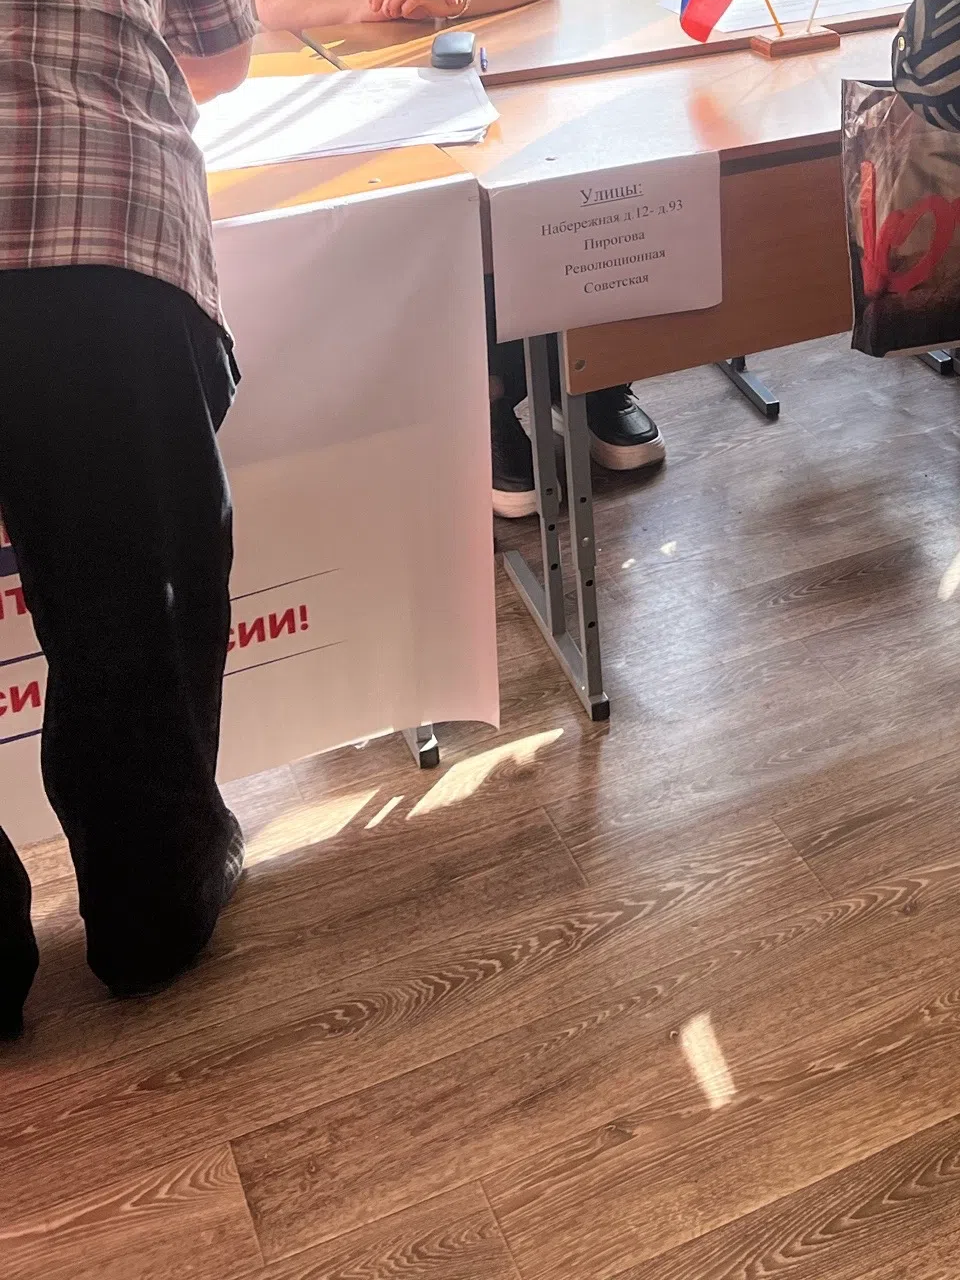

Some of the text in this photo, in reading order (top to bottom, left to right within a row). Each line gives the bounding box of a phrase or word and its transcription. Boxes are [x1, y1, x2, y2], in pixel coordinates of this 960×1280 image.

[580, 183, 644, 205] Улицы:
[541, 213, 620, 237] Набережная
[657, 199, 684, 216] д.93
[583, 231, 646, 252] Пирогова
[564, 249, 667, 276] Революционная
[583, 274, 650, 295] Советская
